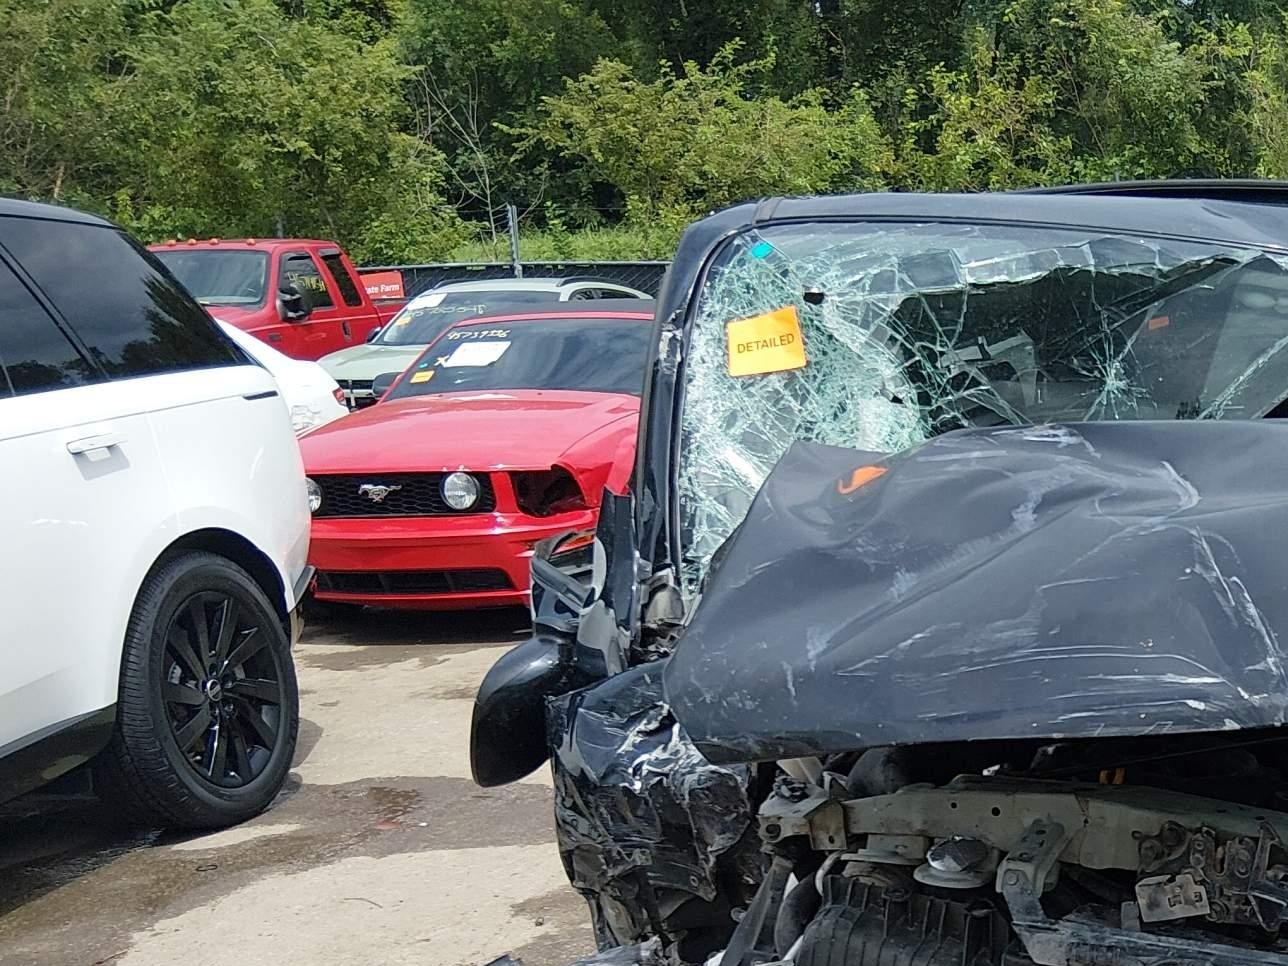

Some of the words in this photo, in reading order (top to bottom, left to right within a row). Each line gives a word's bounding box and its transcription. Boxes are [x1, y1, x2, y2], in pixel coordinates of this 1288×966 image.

[365, 286, 379, 294] ate
[380, 284, 400, 293] Farm
[737, 333, 795, 354] DETAILED
